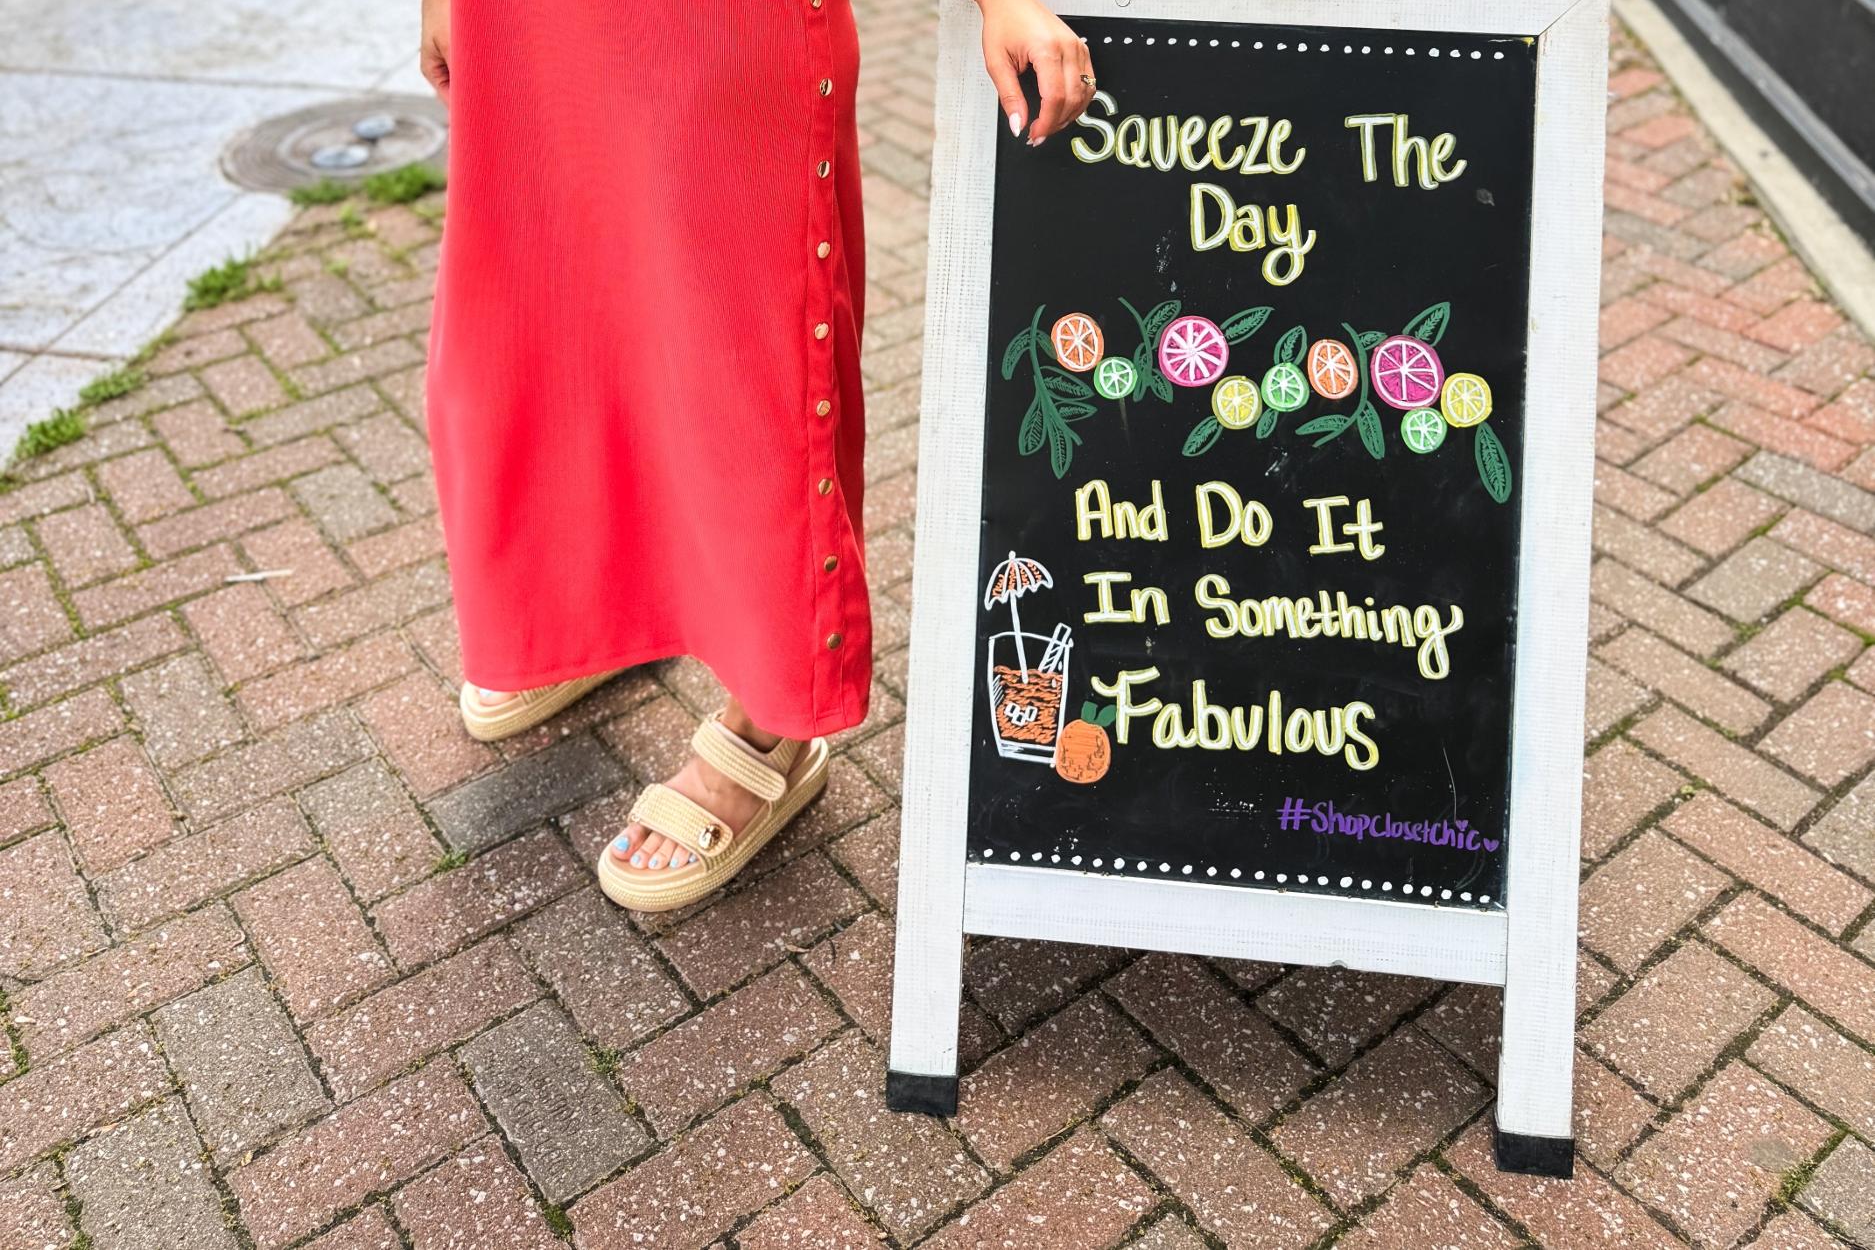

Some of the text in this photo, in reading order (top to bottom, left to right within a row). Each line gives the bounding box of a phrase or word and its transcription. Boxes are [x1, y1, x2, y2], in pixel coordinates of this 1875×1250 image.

[1071, 90, 1467, 190] Squeeze The
[1190, 182, 1316, 286] Day
[1075, 479, 1385, 560] And Do It
[1083, 571, 1463, 680] In Something
[1090, 665, 1379, 771] Fabulous
